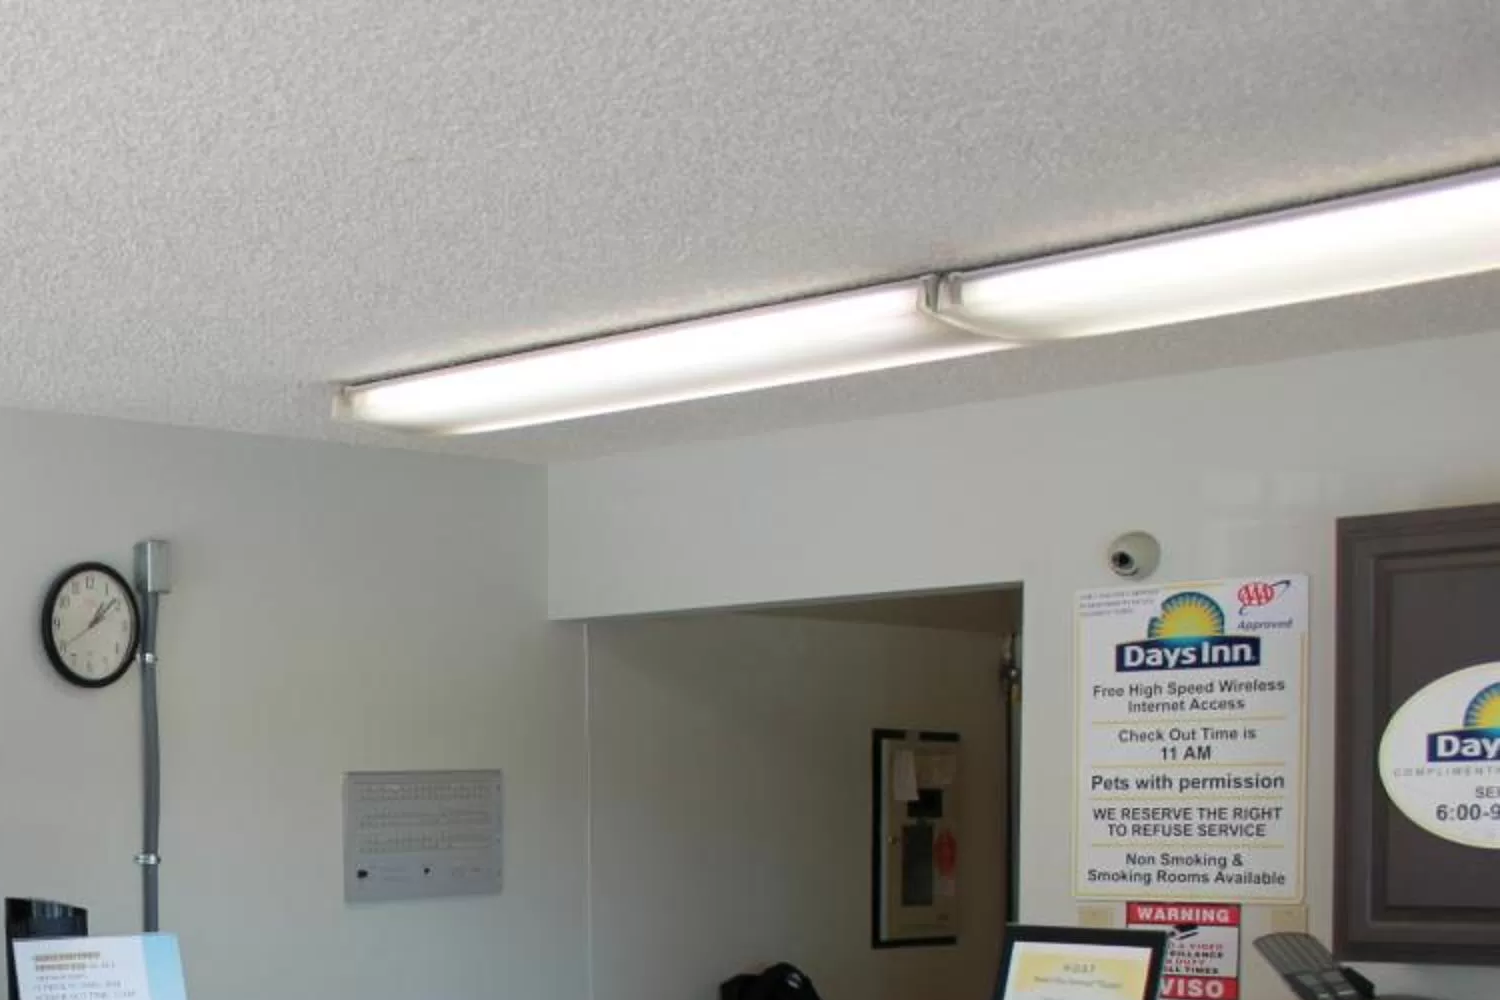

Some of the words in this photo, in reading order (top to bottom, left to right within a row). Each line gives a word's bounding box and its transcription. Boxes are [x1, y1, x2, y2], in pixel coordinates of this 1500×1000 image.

[1124, 645, 1195, 669] Days
[1202, 642, 1252, 664] Inn
[1093, 685, 1124, 698] Free
[1129, 683, 1162, 698] High
[1167, 681, 1214, 697] Speed
[1218, 678, 1285, 693] Wireless
[1128, 699, 1184, 714] Internet
[1189, 698, 1245, 711] Access
[1118, 729, 1163, 743] Check
[1169, 728, 1196, 741] Out
[1202, 727, 1238, 740] Time
[1243, 727, 1256, 740] is
[1160, 747, 1177, 761] 11
[1183, 745, 1212, 760] AM
[1436, 733, 1500, 758] Day
[1091, 775, 1129, 791] Pets
[1135, 774, 1173, 791] with
[1178, 773, 1285, 793] permission
[1092, 808, 1116, 821] WE
[1121, 807, 1192, 821] RESERVE
[1196, 807, 1228, 821] THE
[1233, 806, 1282, 820] RIGHT
[1108, 824, 1127, 837] TO
[1131, 824, 1193, 837] REFUSE
[1198, 824, 1266, 837] SERVICE
[1125, 852, 1155, 865] Non
[1160, 852, 1227, 868] Smoking
[1232, 853, 1243, 866] &
[1087, 869, 1151, 885] Smoking
[1156, 870, 1209, 884] Rooms
[1214, 870, 1285, 885] Available
[1138, 907, 1229, 922] WARNING
[1160, 978, 1224, 998] VISO
